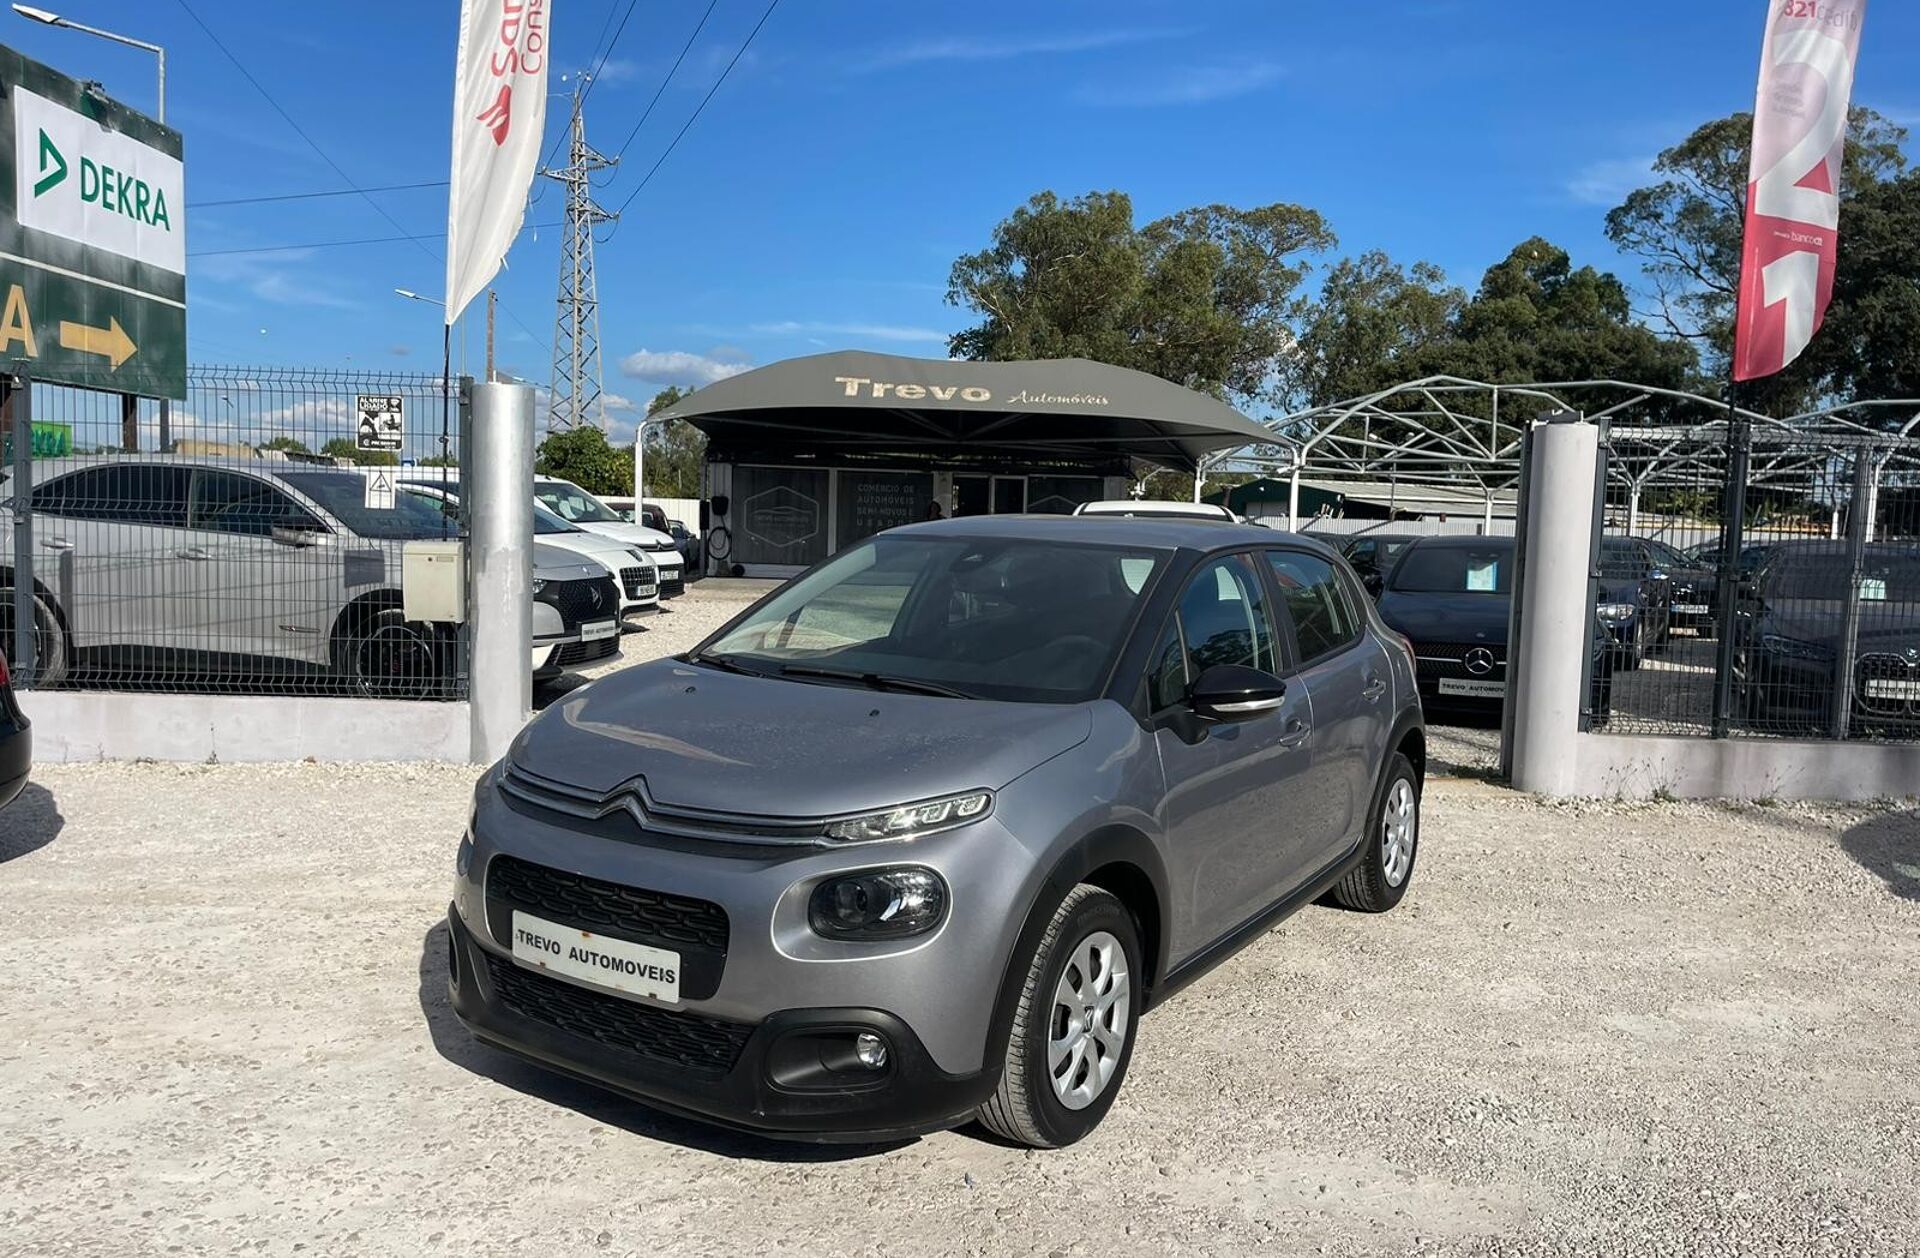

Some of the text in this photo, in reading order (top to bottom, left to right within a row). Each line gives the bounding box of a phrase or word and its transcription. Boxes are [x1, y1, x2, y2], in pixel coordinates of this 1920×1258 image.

[80, 155, 171, 232] DEKRA
[834, 376, 1109, 406] Trevo Automóveis
[1442, 683, 1466, 691] TREVO
[517, 929, 676, 984] TREVO AUTOMOVEIS
